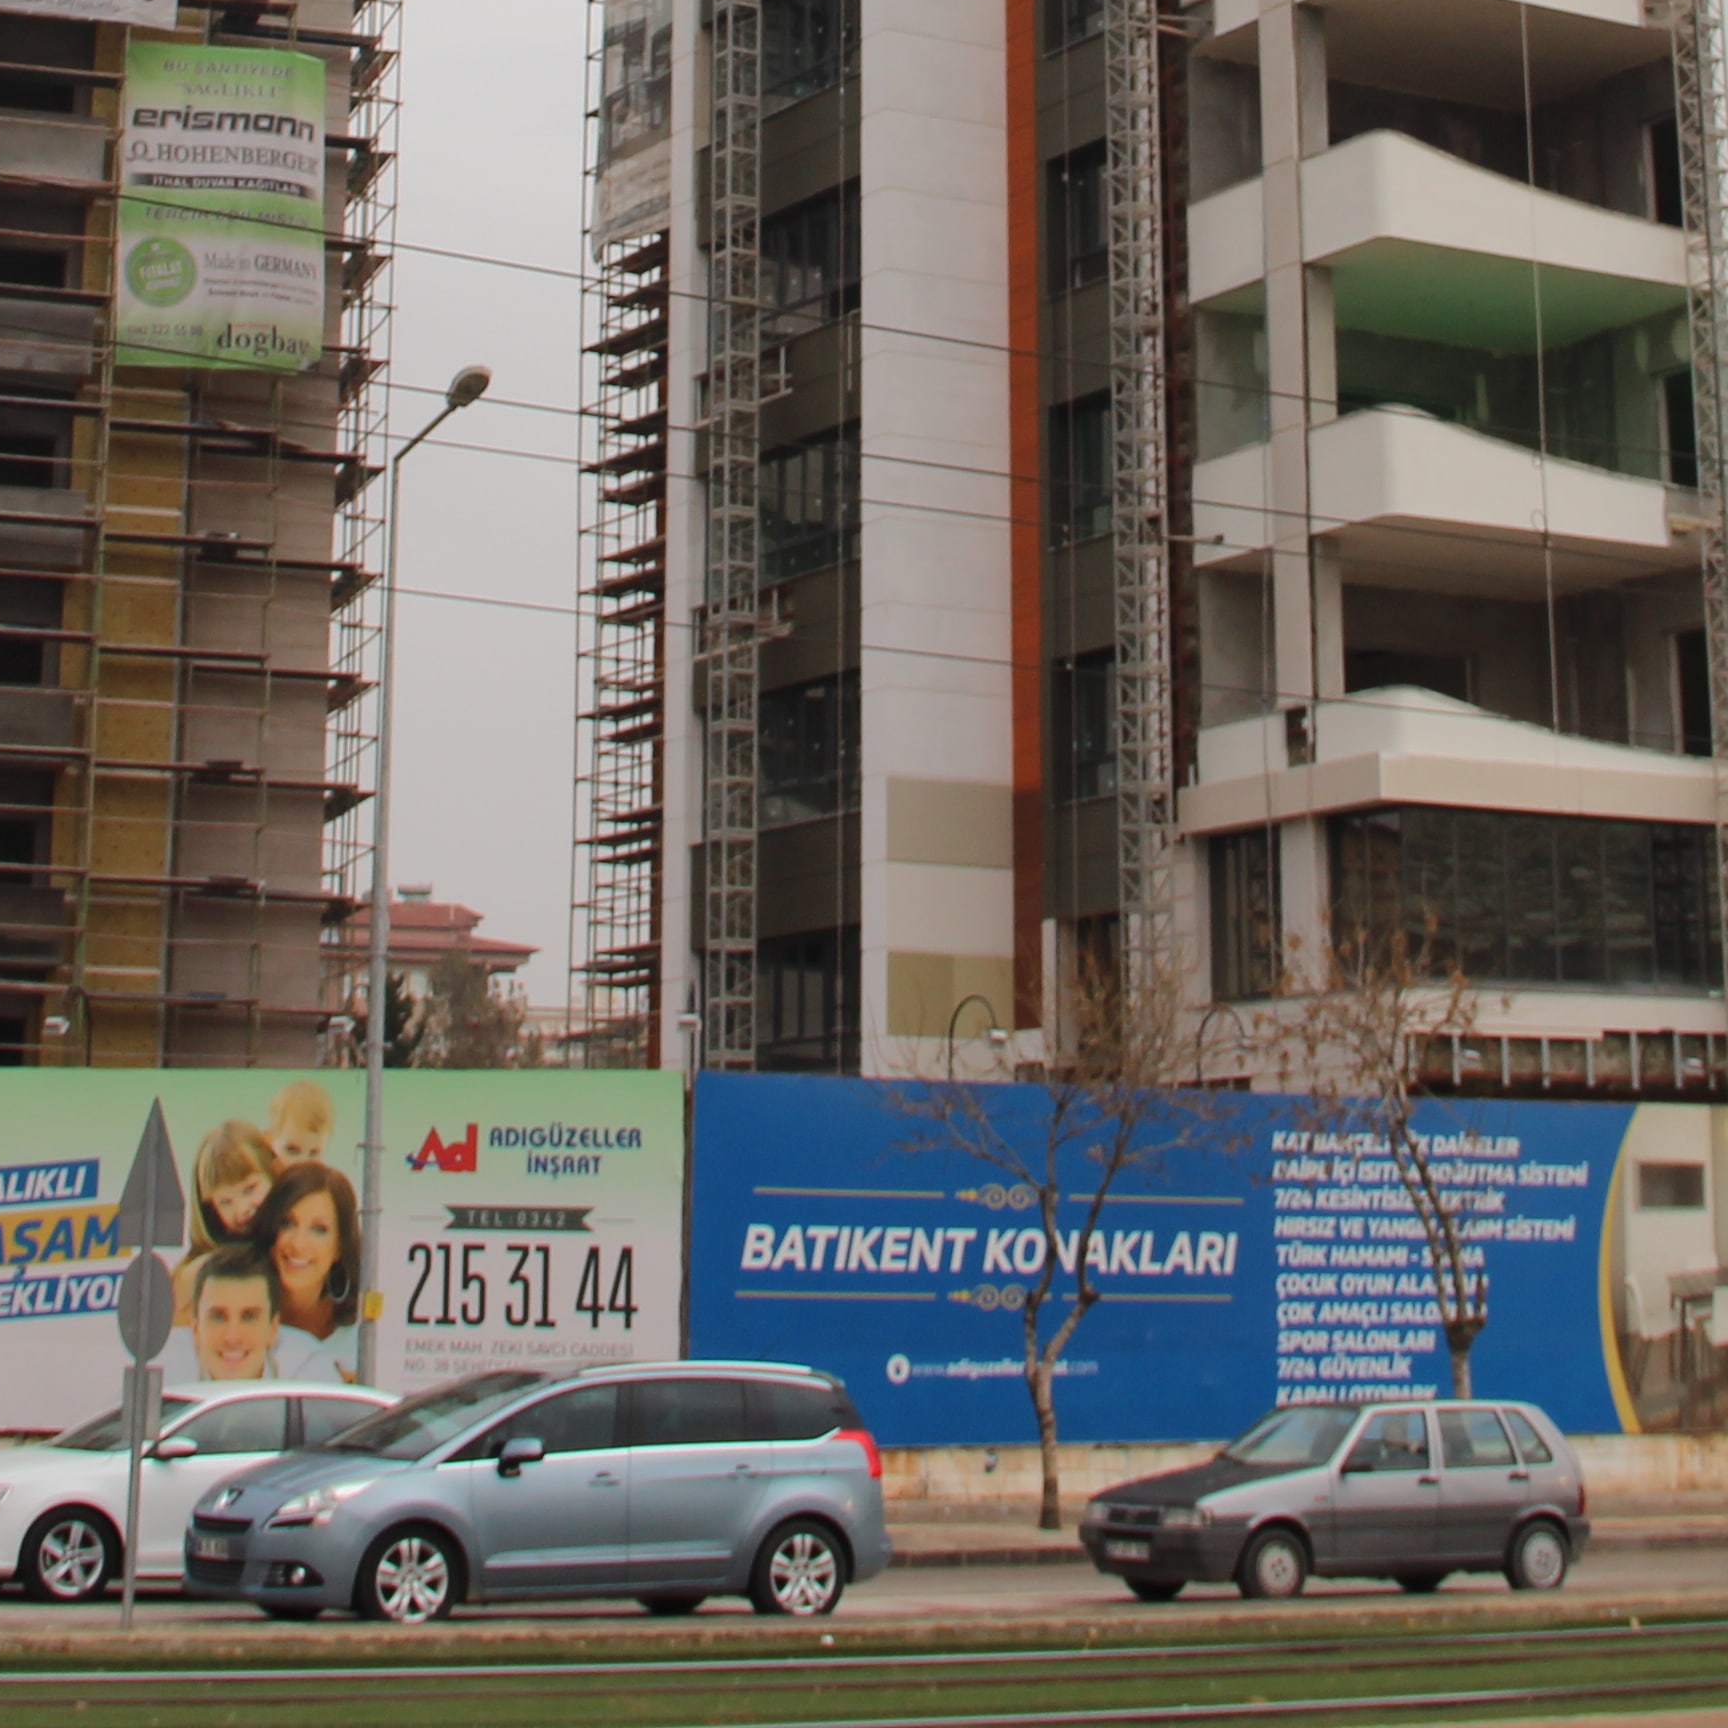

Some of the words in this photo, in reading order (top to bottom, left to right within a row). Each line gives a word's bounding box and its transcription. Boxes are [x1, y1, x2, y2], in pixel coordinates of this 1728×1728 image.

[132, 105, 315, 143] erismann
[489, 1122, 642, 1149] ADIGÜZELLER
[1272, 1130, 1311, 1153] KAT
[526, 1153, 603, 1181] İNŞAAT
[1517, 1159, 1589, 1187] SİSTEMİ
[1274, 1186, 1314, 1210] 7/24
[1274, 1215, 1337, 1239] HIRSIZ
[1340, 1216, 1365, 1239] VE
[1504, 1214, 1576, 1242] SİSTEMİ
[740, 1223, 978, 1274] BATIKENT
[981, 1226, 1239, 1276] KONAKLARI
[1276, 1240, 1328, 1268] TÜRK
[1329, 1244, 1409, 1268] HAMAMI
[406, 1241, 487, 1328] 215
[504, 1242, 557, 1328] 31
[574, 1244, 639, 1330] 44
[1275, 1273, 1339, 1301] ÇOCUK
[1340, 1273, 1395, 1296] OYUN
[1275, 1301, 1317, 1329] ÇOK
[1318, 1301, 1389, 1329] AMAÇLI
[405, 1338, 445, 1355] EMEK
[1276, 1329, 1330, 1354] SPOR
[1331, 1329, 1437, 1354] SALONLARI
[1276, 1356, 1317, 1380] 7/24
[1318, 1352, 1413, 1380] GÜVENLİK
